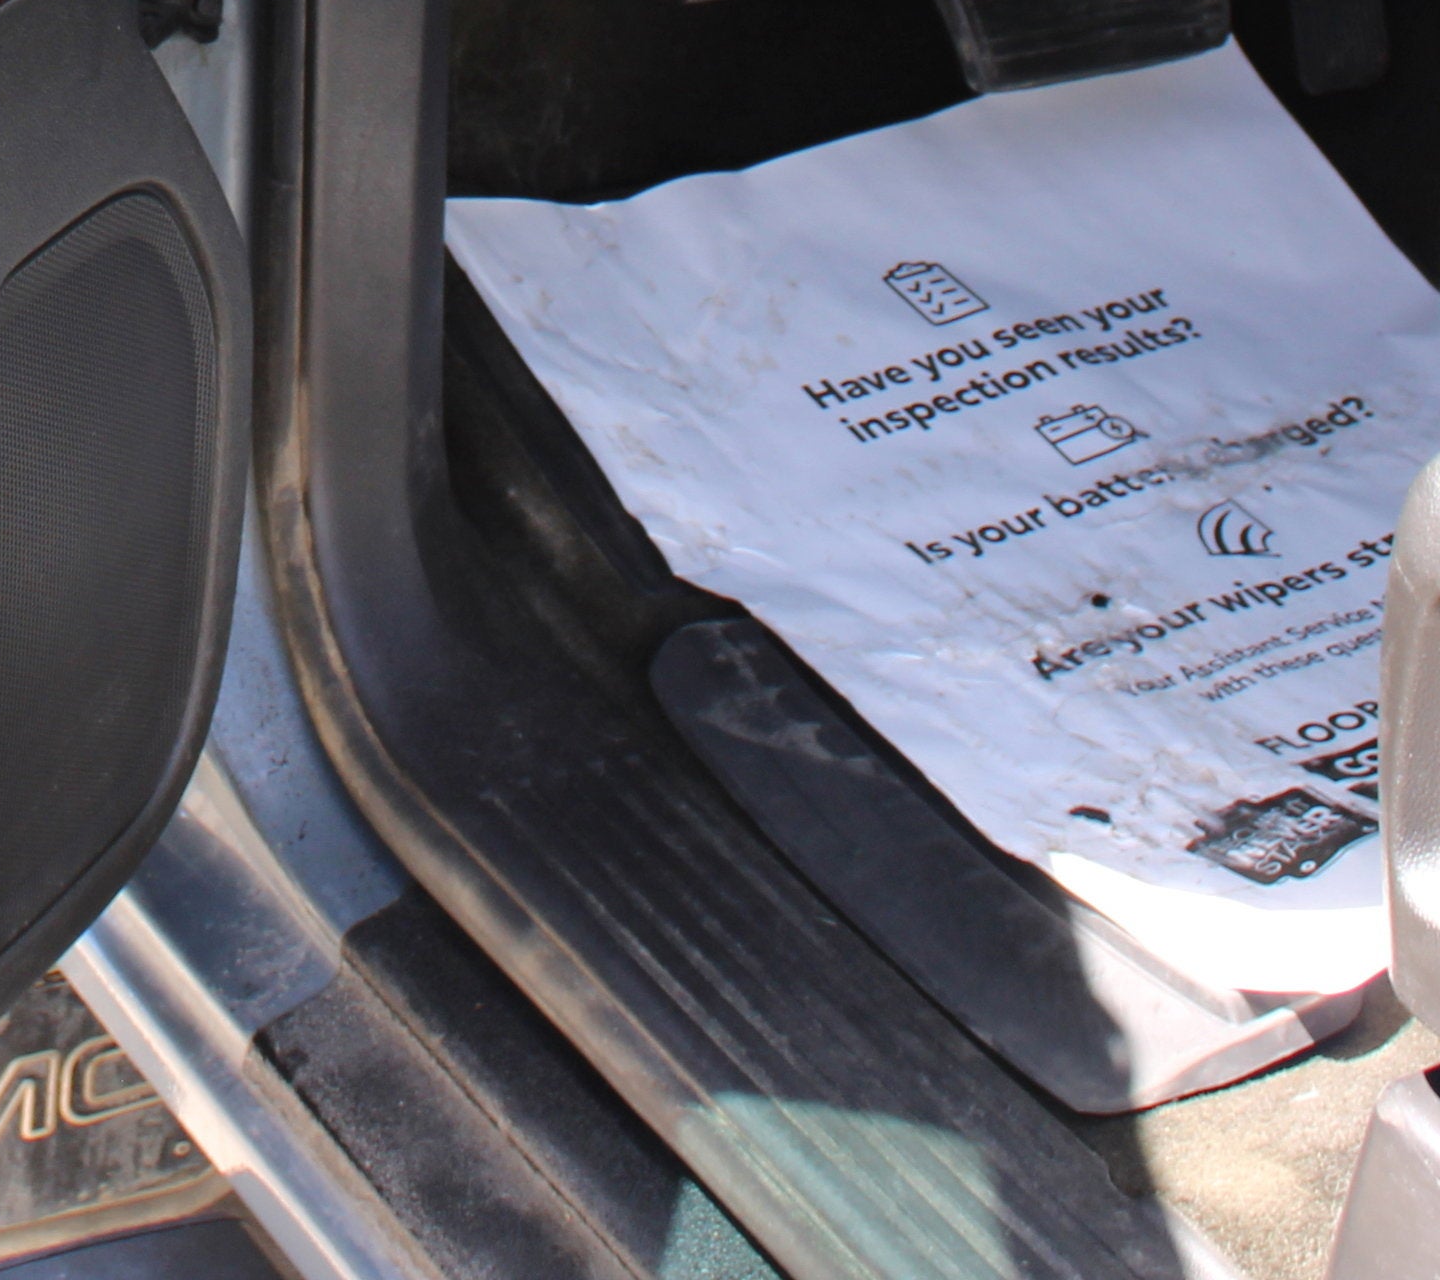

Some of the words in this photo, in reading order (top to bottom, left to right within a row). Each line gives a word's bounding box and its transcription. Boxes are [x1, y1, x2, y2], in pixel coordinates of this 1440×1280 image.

[801, 362, 912, 410] Have
[910, 338, 993, 382] you
[992, 311, 1082, 349] seen
[1081, 287, 1170, 332] your
[839, 355, 1059, 444] inspection
[1057, 316, 1203, 372] results?
[903, 538, 954, 566] Is
[951, 505, 1048, 559] your
[1042, 452, 1210, 519] batter
[1203, 396, 1375, 466] chged?
[1031, 637, 1112, 681] Are
[1117, 600, 1208, 655] your
[1206, 561, 1347, 613] wipers
[1178, 634, 1292, 682] Assistant
[1285, 607, 1375, 642] Service
[1199, 673, 1258, 703] with
[1252, 649, 1326, 681] these
